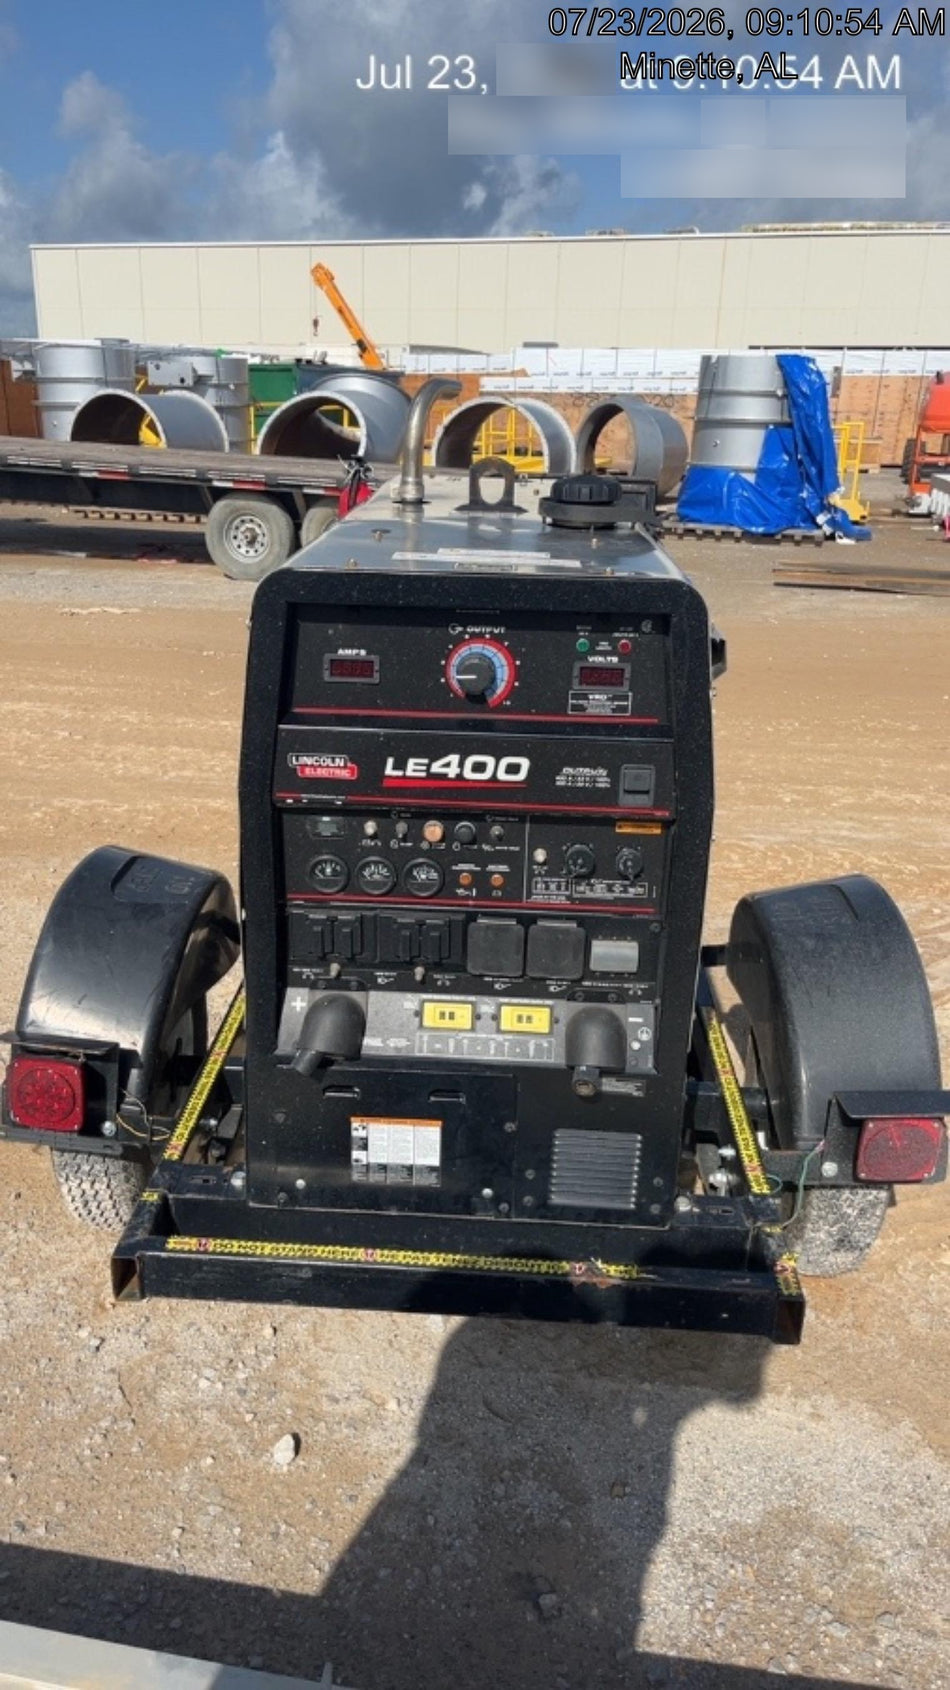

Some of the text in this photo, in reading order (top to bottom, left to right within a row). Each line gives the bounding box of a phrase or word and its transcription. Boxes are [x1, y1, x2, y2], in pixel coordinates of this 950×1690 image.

[337, 648, 367, 656] AMPS
[587, 655, 619, 663] VOLTS
[292, 755, 346, 767] LINCOLN
[304, 767, 352, 777] ELECTRIC
[384, 753, 531, 782] LE400
[213, 1241, 234, 1249] DO
[238, 1242, 266, 1252] NOT
[270, 1244, 318, 1255] STAND
